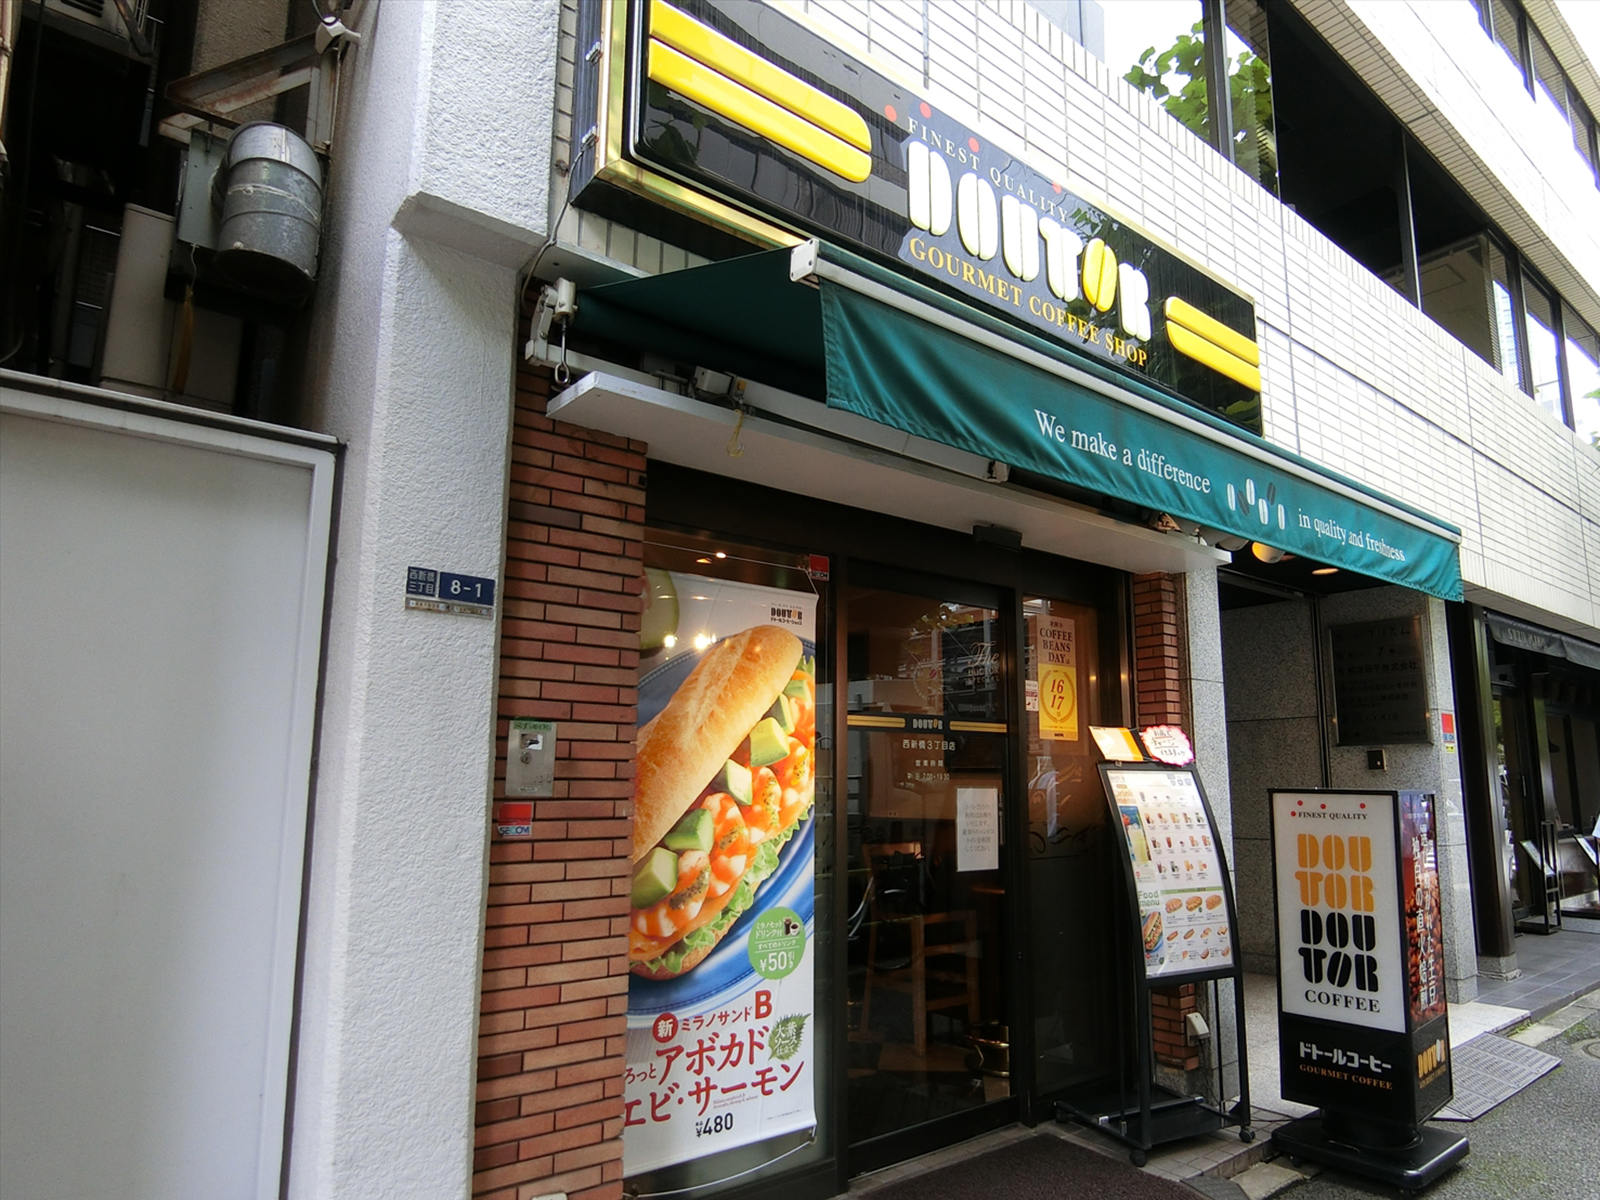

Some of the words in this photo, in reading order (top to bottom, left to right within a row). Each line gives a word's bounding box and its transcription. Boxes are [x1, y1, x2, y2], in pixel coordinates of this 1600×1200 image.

[908, 117, 980, 171] FINEST
[990, 166, 1068, 223] QUALITY
[908, 140, 1152, 342] DOUTOR
[909, 237, 1023, 307] GOURMET
[1028, 295, 1100, 345] COFFEE
[1105, 330, 1147, 367] SHOP
[1034, 409, 1065, 442] We
[1071, 430, 1117, 461] make
[1123, 448, 1133, 466] a
[1137, 448, 1211, 494] difference
[1299, 508, 1311, 528] in
[1314, 517, 1347, 546] quality
[1348, 530, 1363, 548] and
[1366, 533, 1405, 562] freshness
[410, 569, 435, 582] 西新橋
[408, 581, 434, 594] 三丁目
[450, 579, 482, 598] 8-1
[771, 607, 803, 620] DOUTOR
[1040, 627, 1073, 642] COFFEE
[1043, 640, 1071, 653] BEANS
[1048, 652, 1065, 664] DAY
[1050, 679, 1065, 694] 16
[1050, 694, 1065, 710] 17
[913, 718, 943, 730] DOUTOR
[1298, 811, 1327, 820] FINEST
[1328, 811, 1368, 821] QUALITY
[1297, 833, 1372, 873] DOU
[1139, 890, 1159, 899] Food
[1294, 870, 1375, 912] TOR
[1140, 899, 1160, 907] menu
[756, 929, 783, 939] ドリンク付
[1300, 909, 1376, 951] DOU
[1298, 947, 1379, 993] TOR
[1304, 988, 1381, 1014] COFFEE
[658, 1019, 674, 1038] 新
[655, 1025, 770, 1085] アボカド
[1299, 1041, 1392, 1073] ドトールコーヒー
[1299, 1063, 1349, 1082] GOURMET
[1351, 1072, 1393, 1091] COFFEE
[624, 1060, 805, 1127] エビ・サーモン
[696, 1112, 733, 1138] ¥480
